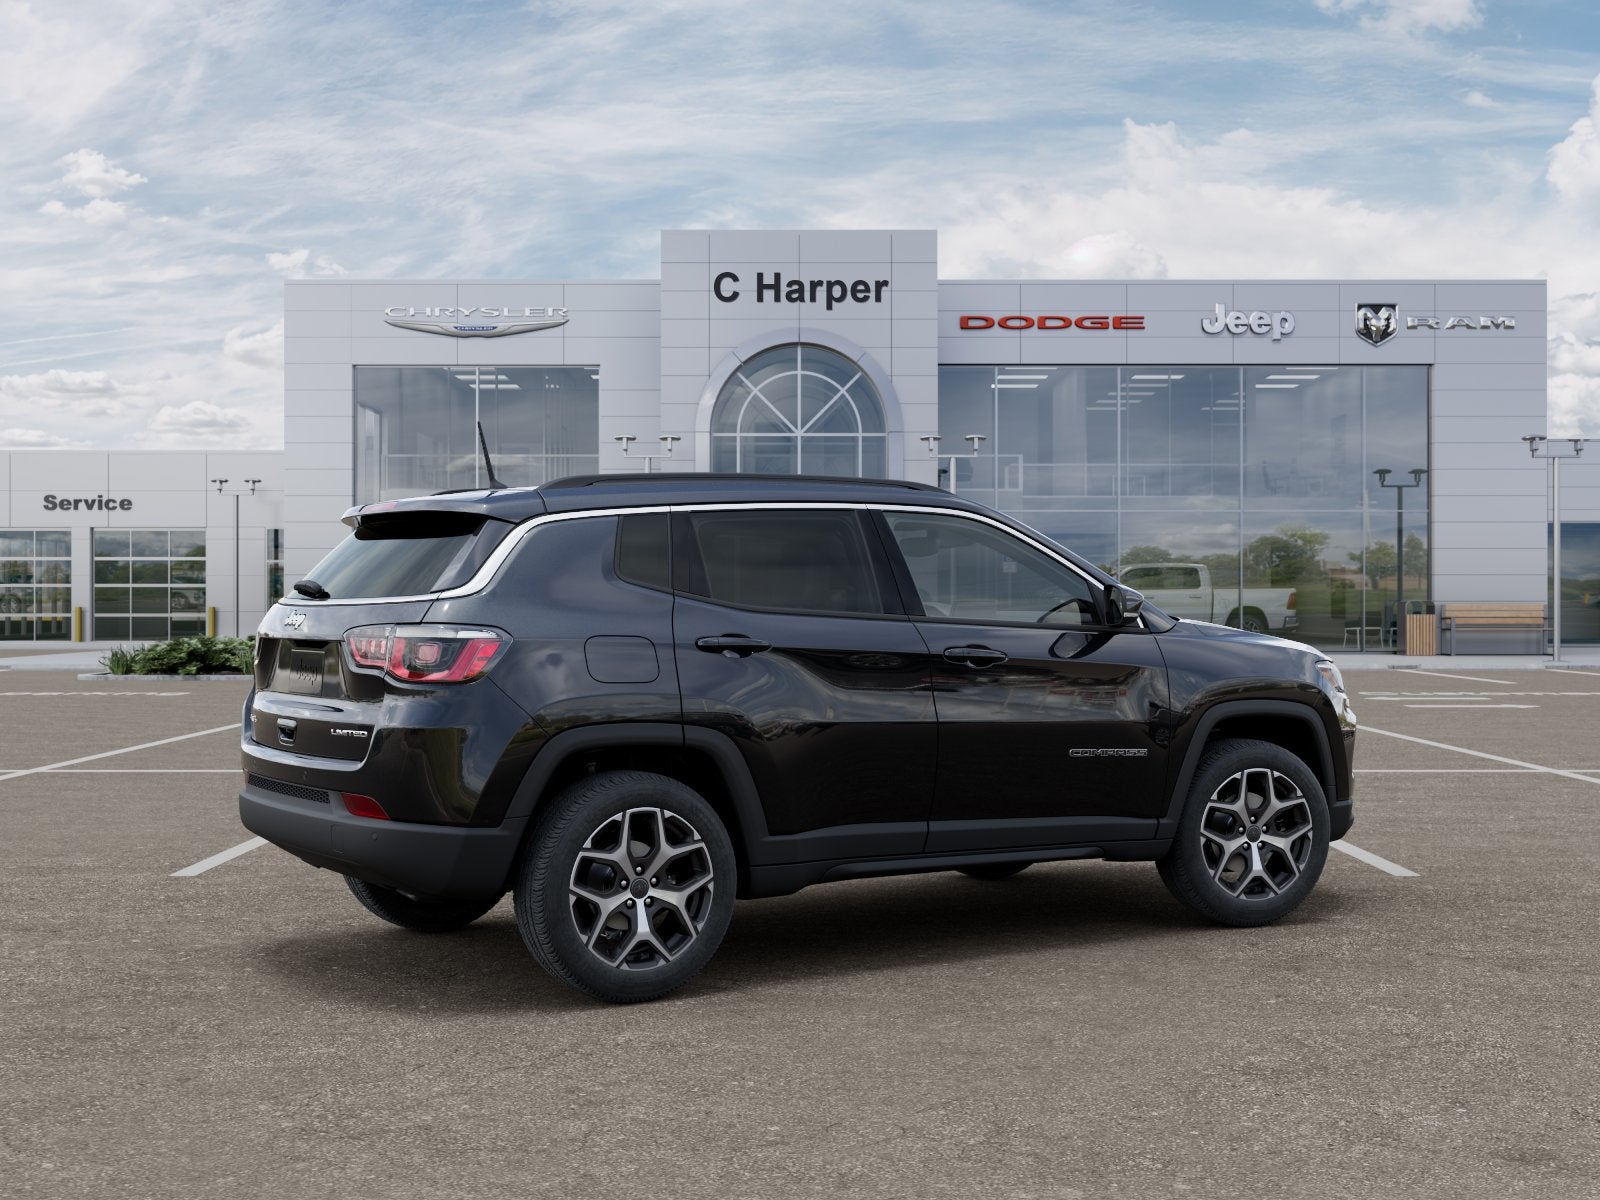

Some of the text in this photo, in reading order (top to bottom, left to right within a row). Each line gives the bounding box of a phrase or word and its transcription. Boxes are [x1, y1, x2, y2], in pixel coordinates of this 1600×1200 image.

[713, 271, 890, 311] C Harper
[384, 306, 569, 318] CHRYSLER
[959, 315, 1146, 330] DODGE
[1201, 302, 1296, 343] Jeep
[1406, 315, 1516, 330] RAM
[43, 494, 133, 511] Service
[1069, 748, 1149, 757] COMPASS
